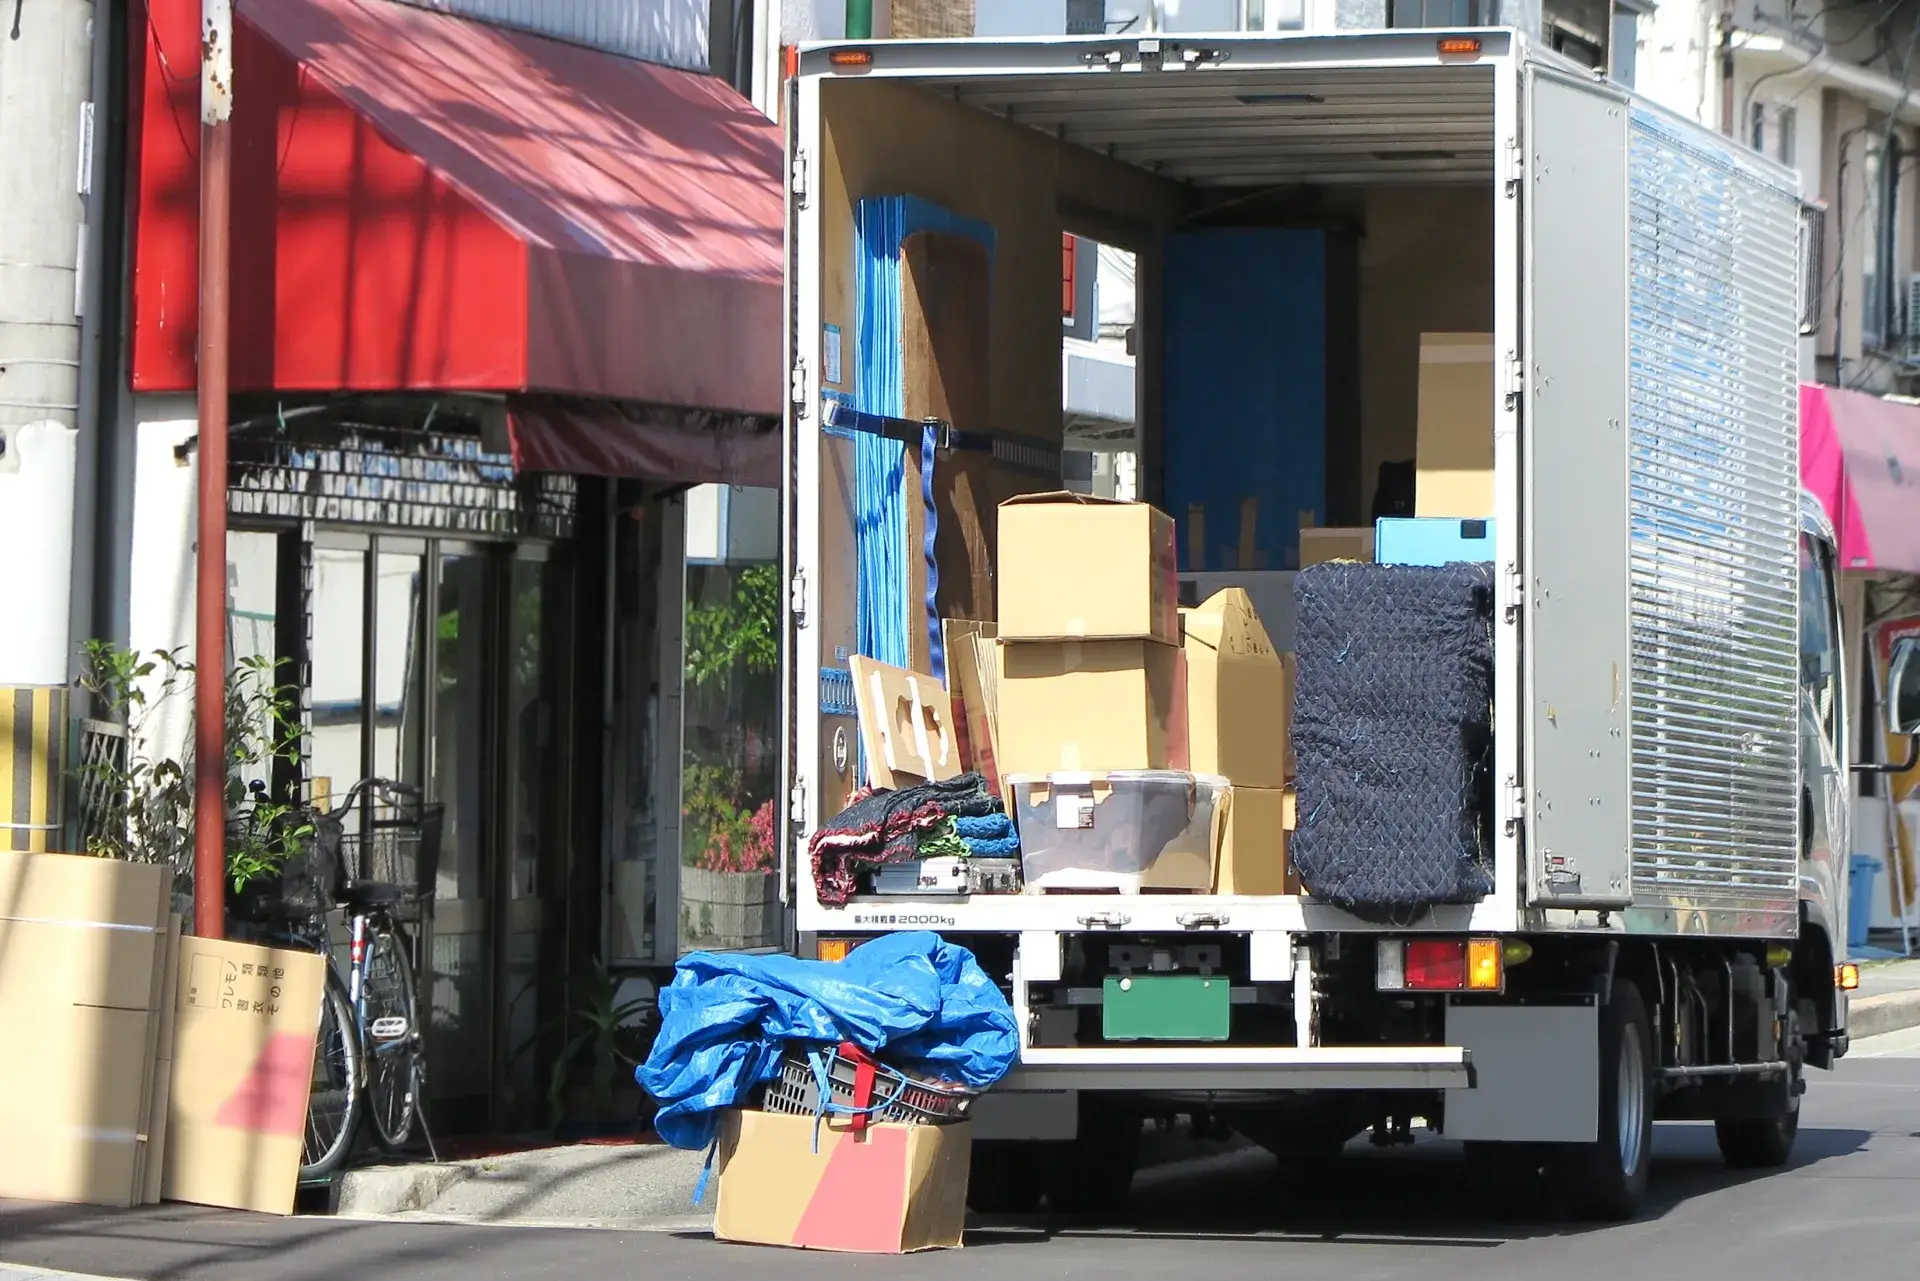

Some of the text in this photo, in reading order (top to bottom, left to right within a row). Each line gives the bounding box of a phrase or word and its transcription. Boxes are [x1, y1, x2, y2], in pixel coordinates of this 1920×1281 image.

[898, 915, 955, 926] 2000kg
[221, 960, 237, 1009] ワレモノ
[252, 965, 268, 1014] 衣類
[267, 967, 284, 1016] その他
